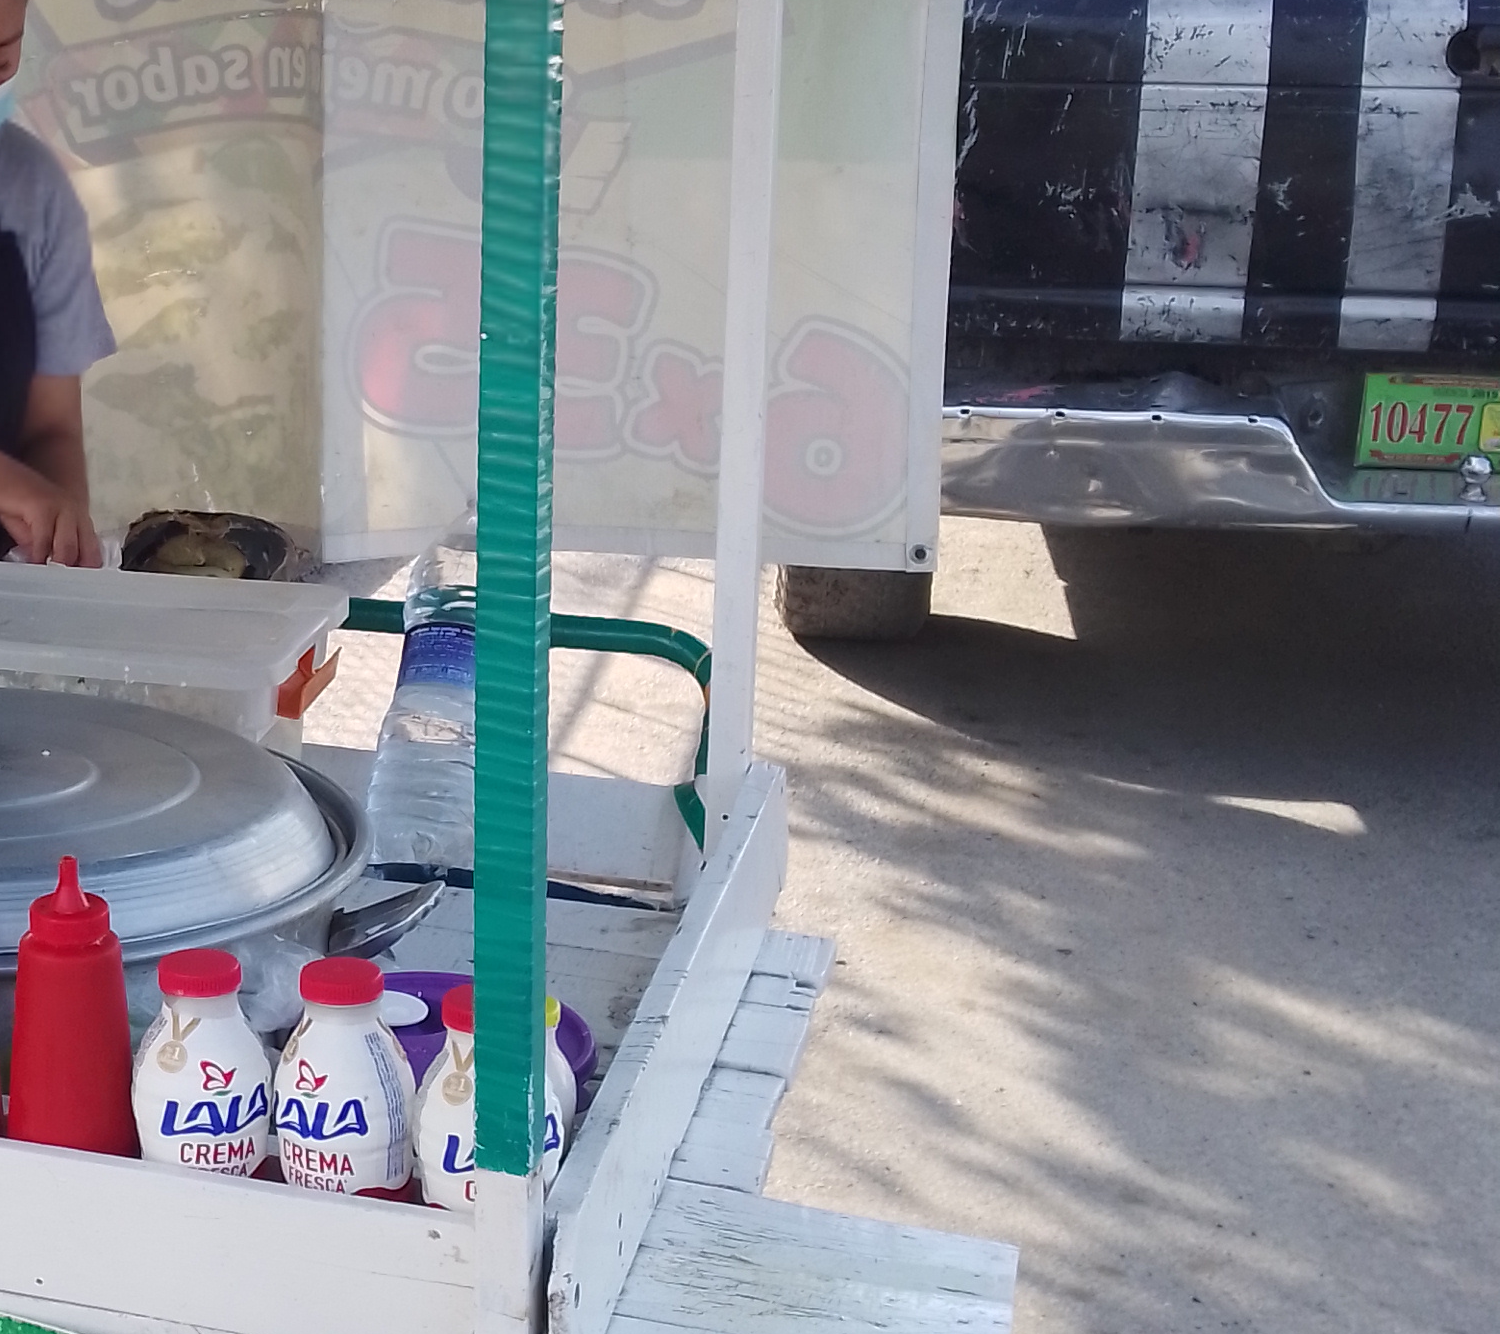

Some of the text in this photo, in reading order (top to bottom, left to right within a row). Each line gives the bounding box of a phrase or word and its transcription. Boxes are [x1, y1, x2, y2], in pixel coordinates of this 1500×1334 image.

[1370, 401, 1475, 446] 10477
[160, 1082, 269, 1137] LALA
[180, 1137, 256, 1165] CREMA
[283, 1138, 355, 1176] CREMA
